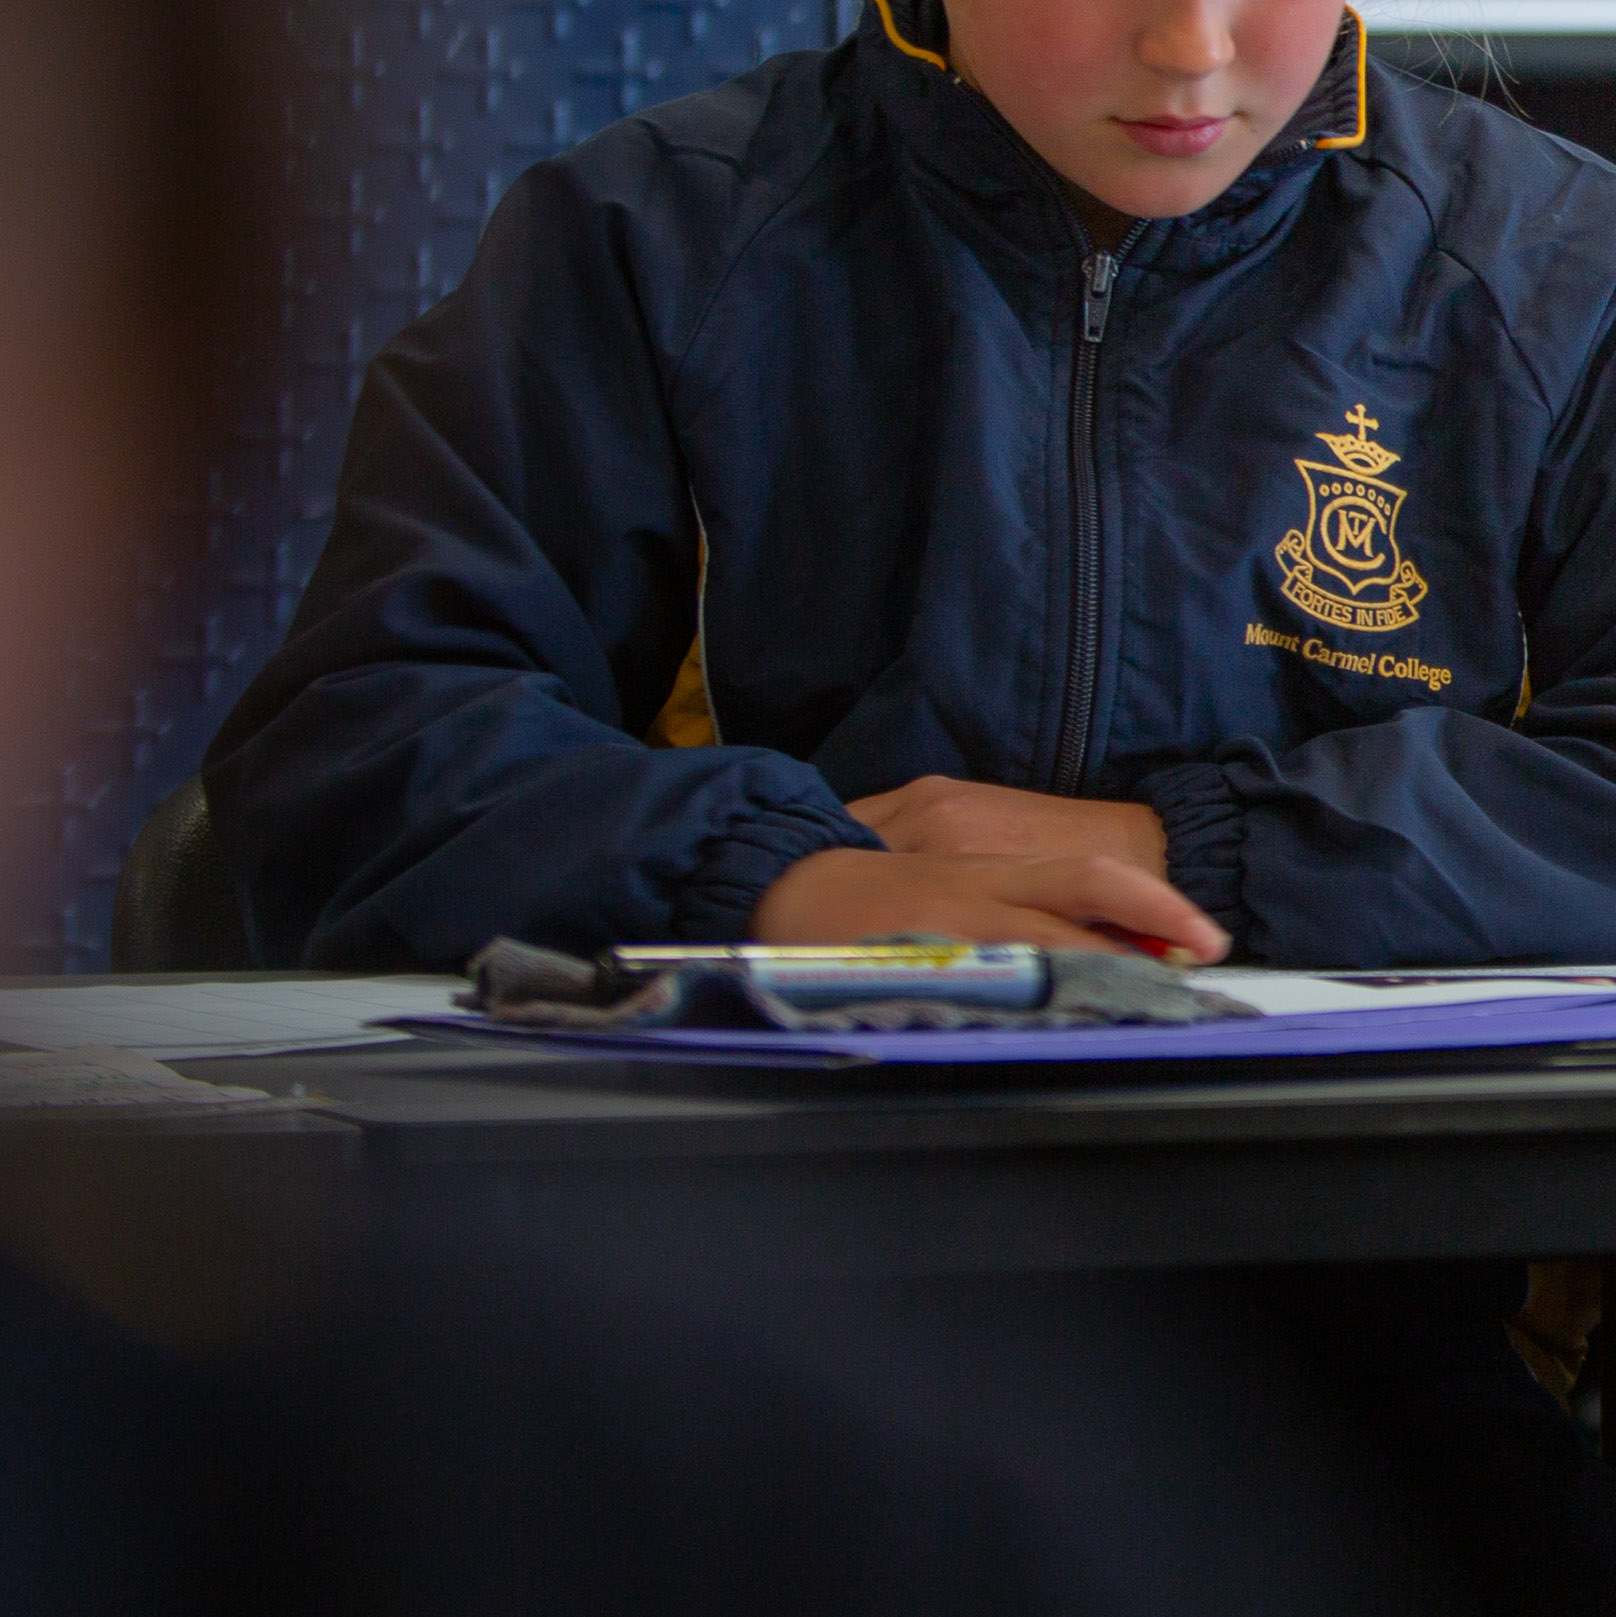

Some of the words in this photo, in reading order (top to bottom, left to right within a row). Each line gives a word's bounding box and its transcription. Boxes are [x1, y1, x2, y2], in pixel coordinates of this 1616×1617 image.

[1291, 581, 1353, 624] FORTES
[1356, 609, 1373, 626] IN
[1376, 605, 1406, 626] FIDE
[1243, 623, 1300, 653] Mount
[1301, 637, 1377, 675] Carmel
[1377, 655, 1453, 691] College
